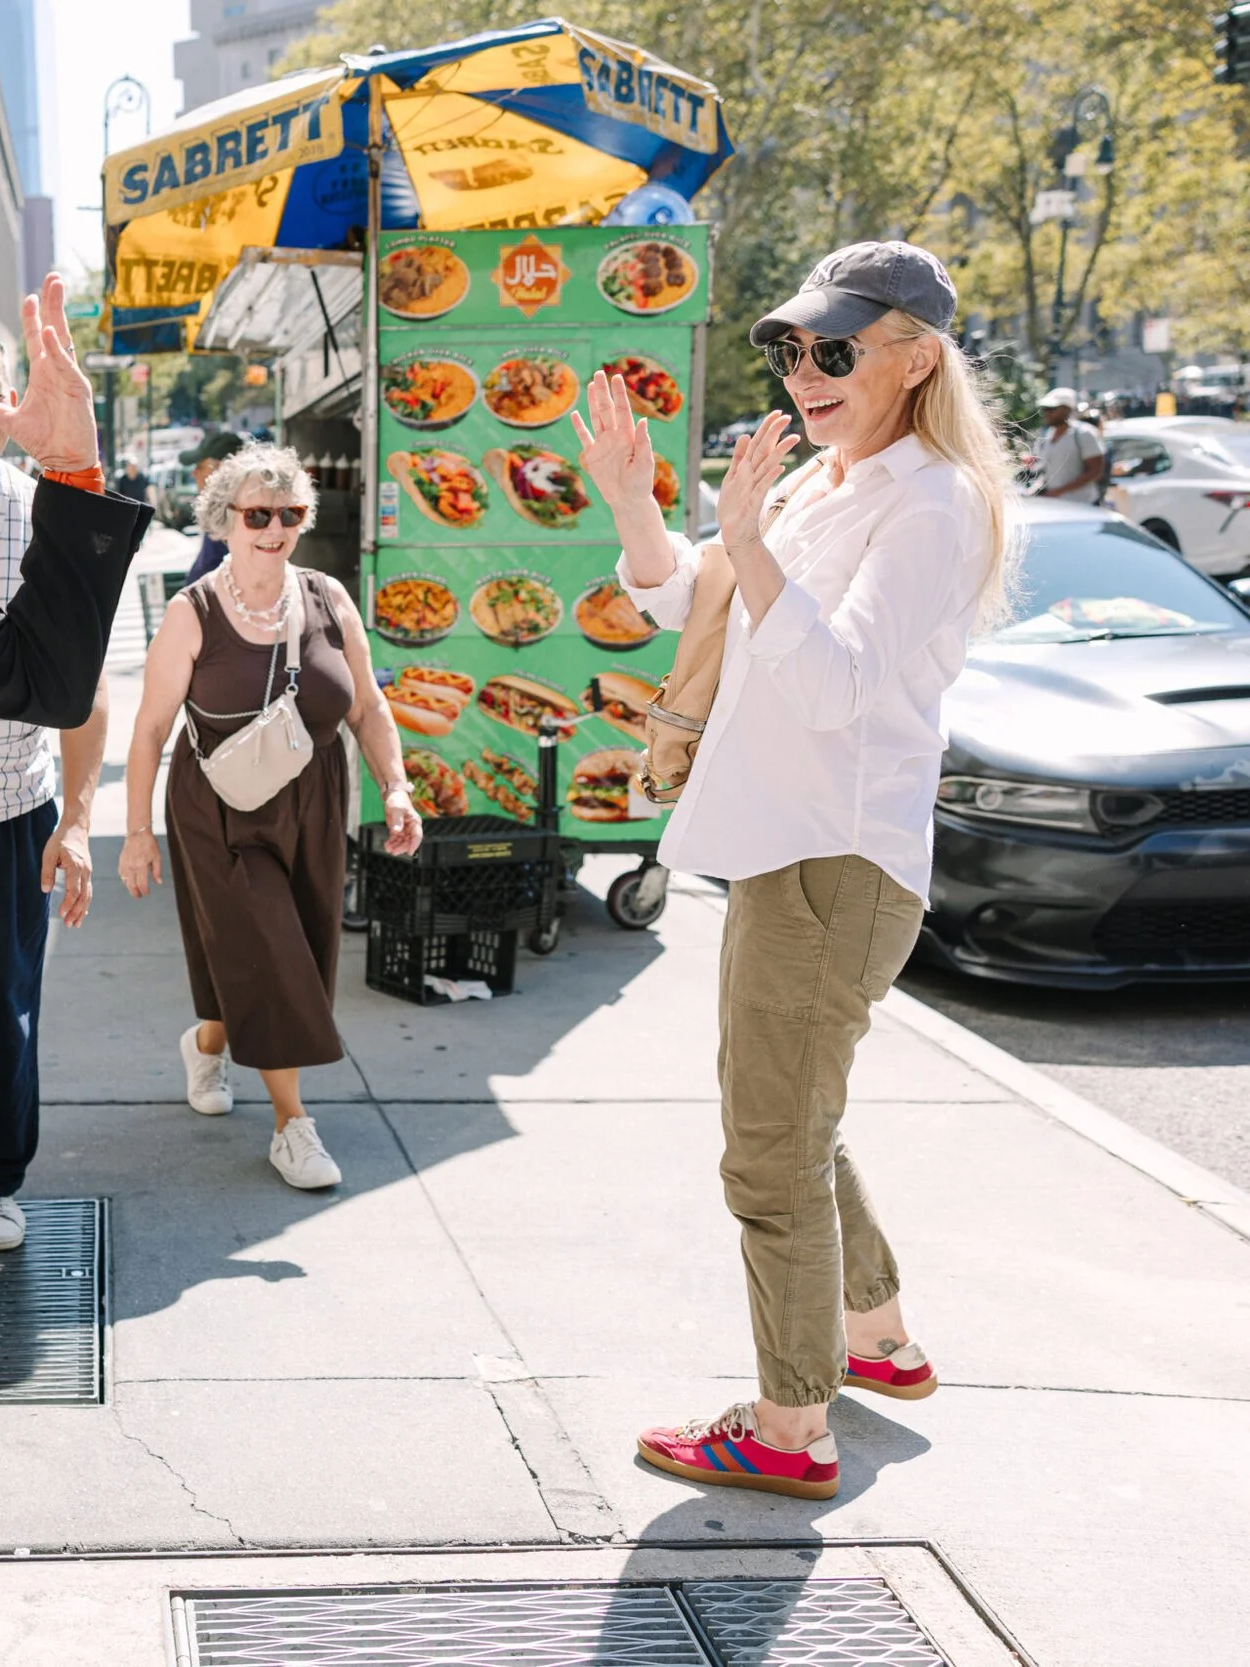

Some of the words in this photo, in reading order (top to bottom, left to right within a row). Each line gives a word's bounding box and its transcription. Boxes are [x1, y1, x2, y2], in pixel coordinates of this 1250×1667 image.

[578, 46, 705, 134] SABRETT
[119, 93, 331, 206] SABRETT
[505, 255, 557, 287] حلال
